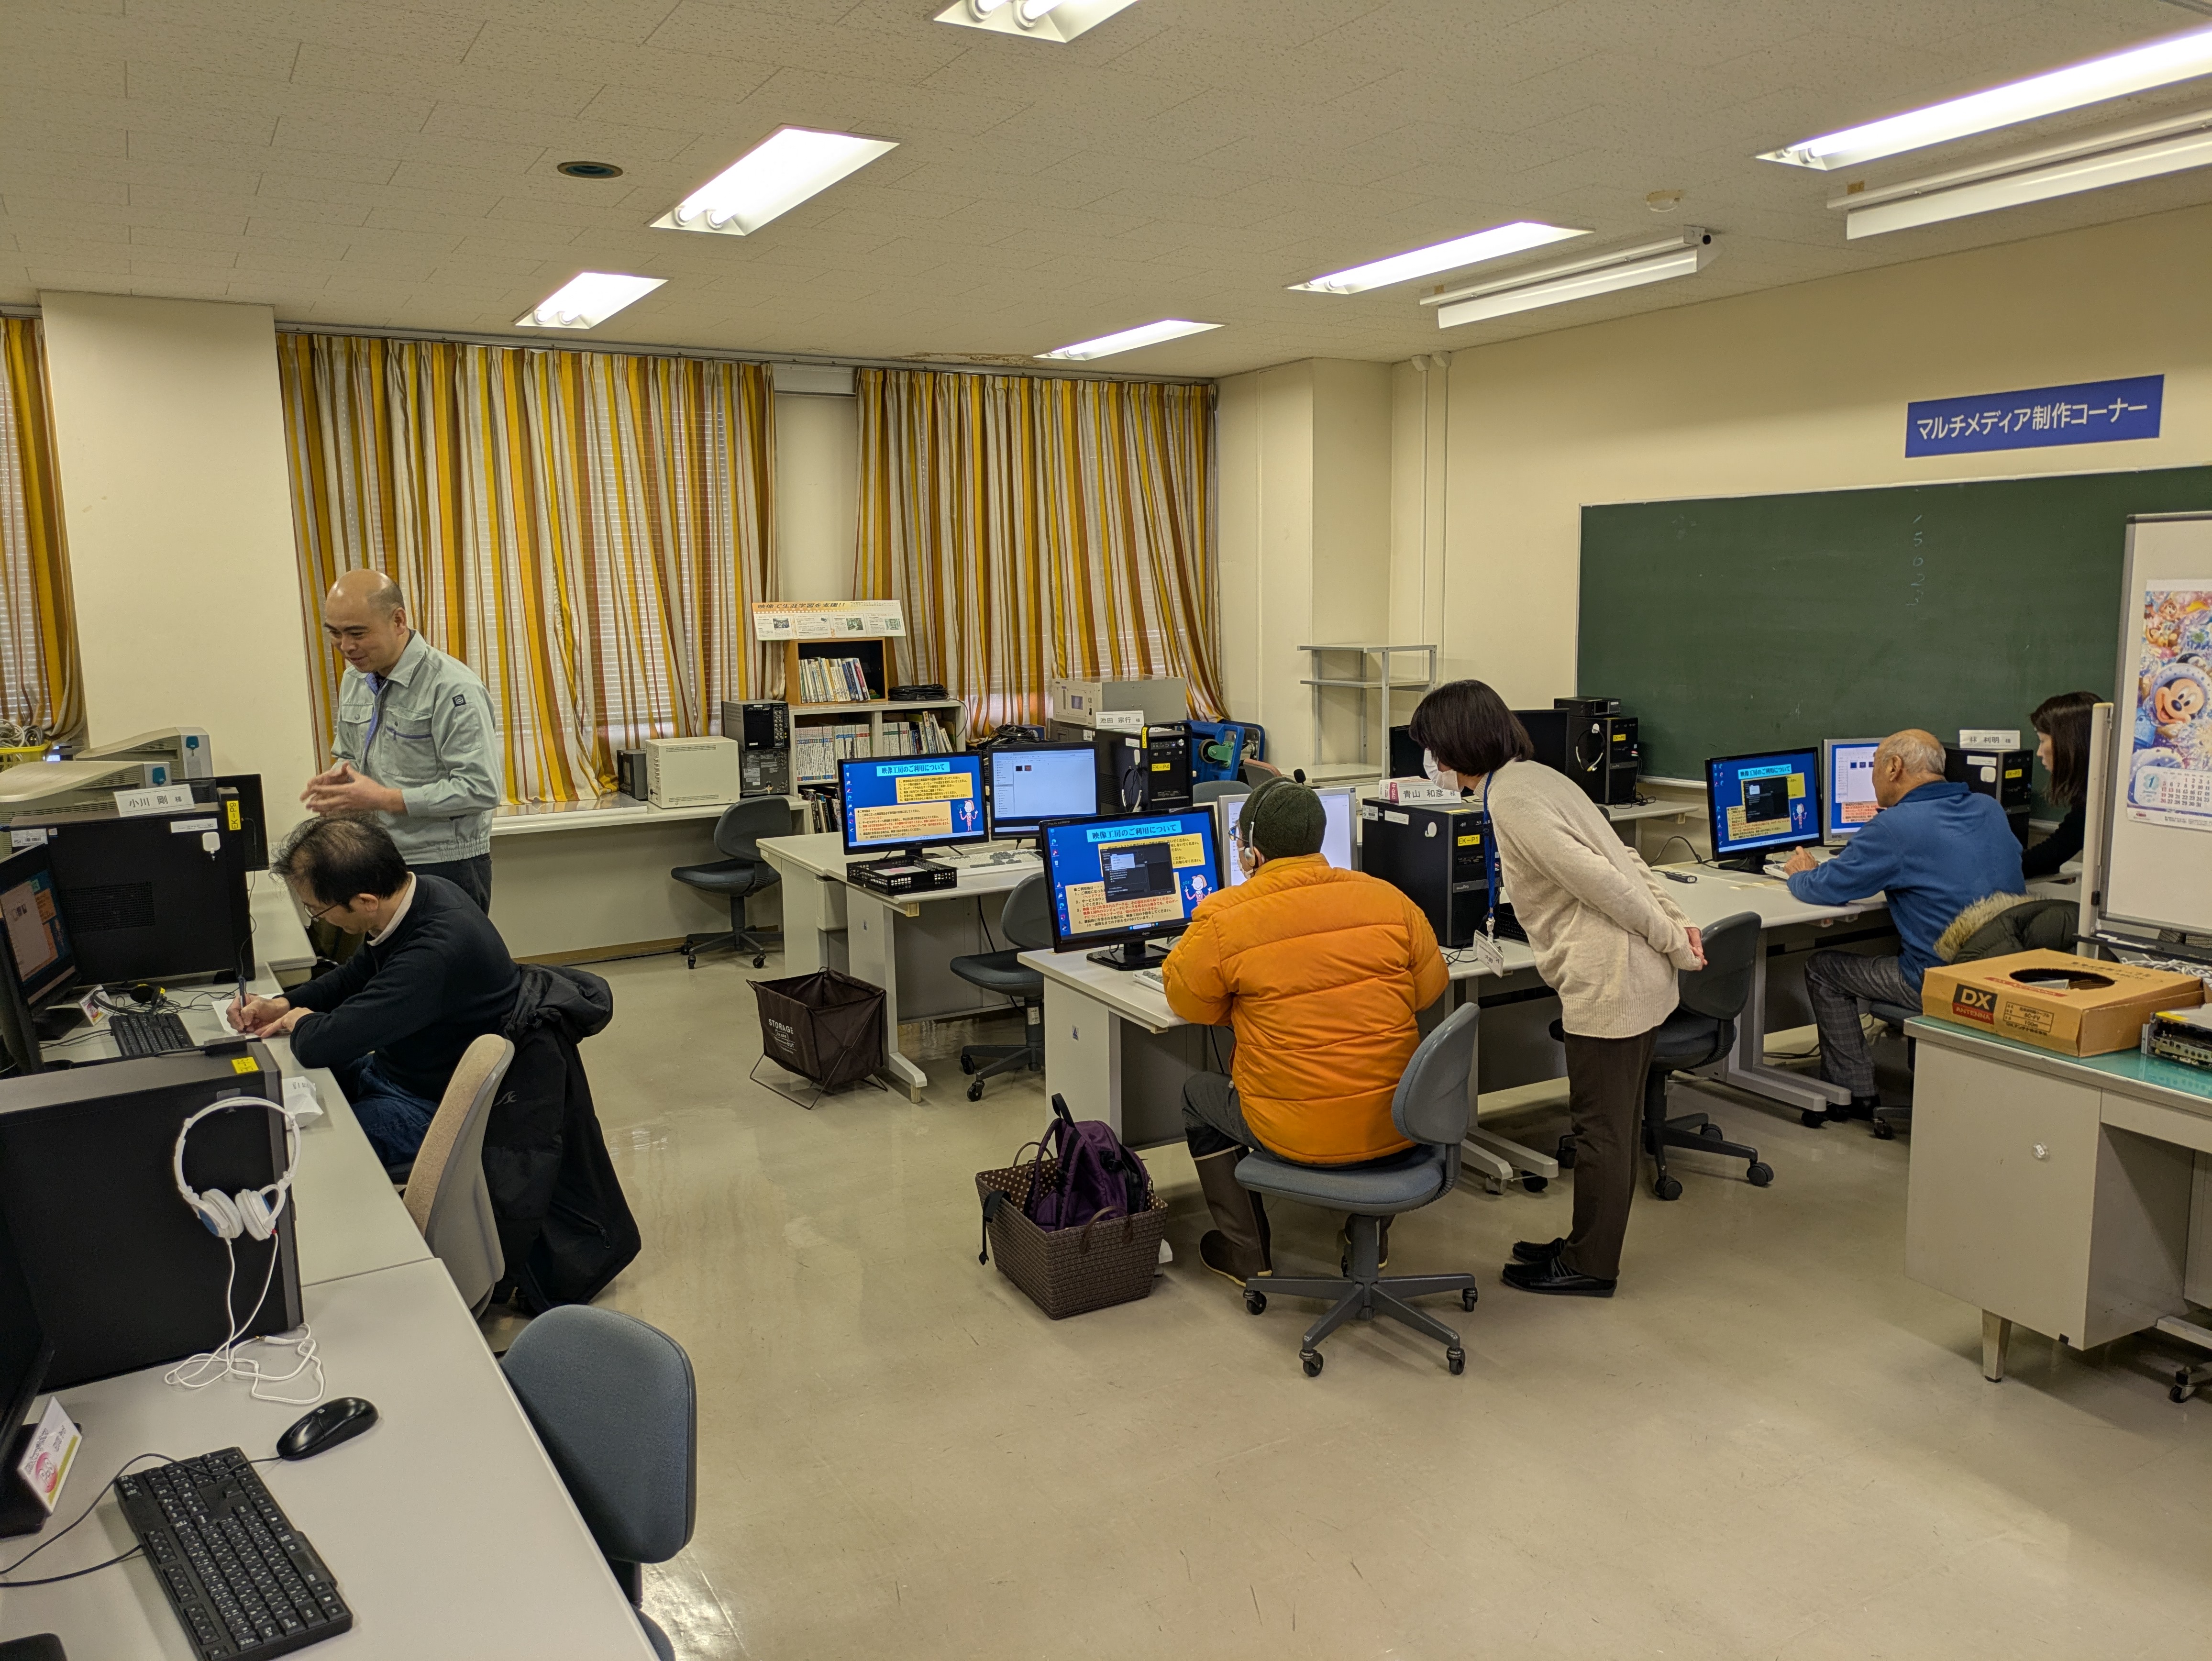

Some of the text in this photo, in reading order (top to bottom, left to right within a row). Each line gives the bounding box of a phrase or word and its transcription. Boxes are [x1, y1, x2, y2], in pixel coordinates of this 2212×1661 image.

[1917, 398, 2148, 440] マルチメディア制作コーナー
[882, 763, 945, 775] 映像工房のご利用について
[2148, 775, 2155, 787] 1
[129, 797, 150, 808] 小川
[157, 795, 168, 805] 剛
[1403, 789, 1420, 799] 青山
[1427, 789, 1444, 797] 和彦
[229, 802, 239, 830] EK-P9
[1092, 824, 1177, 840] 映像工房のご利用について
[1960, 988, 1992, 1010] DX
[1956, 1007, 1991, 1021] ANTENNA
[768, 1019, 794, 1035] STORAGE
